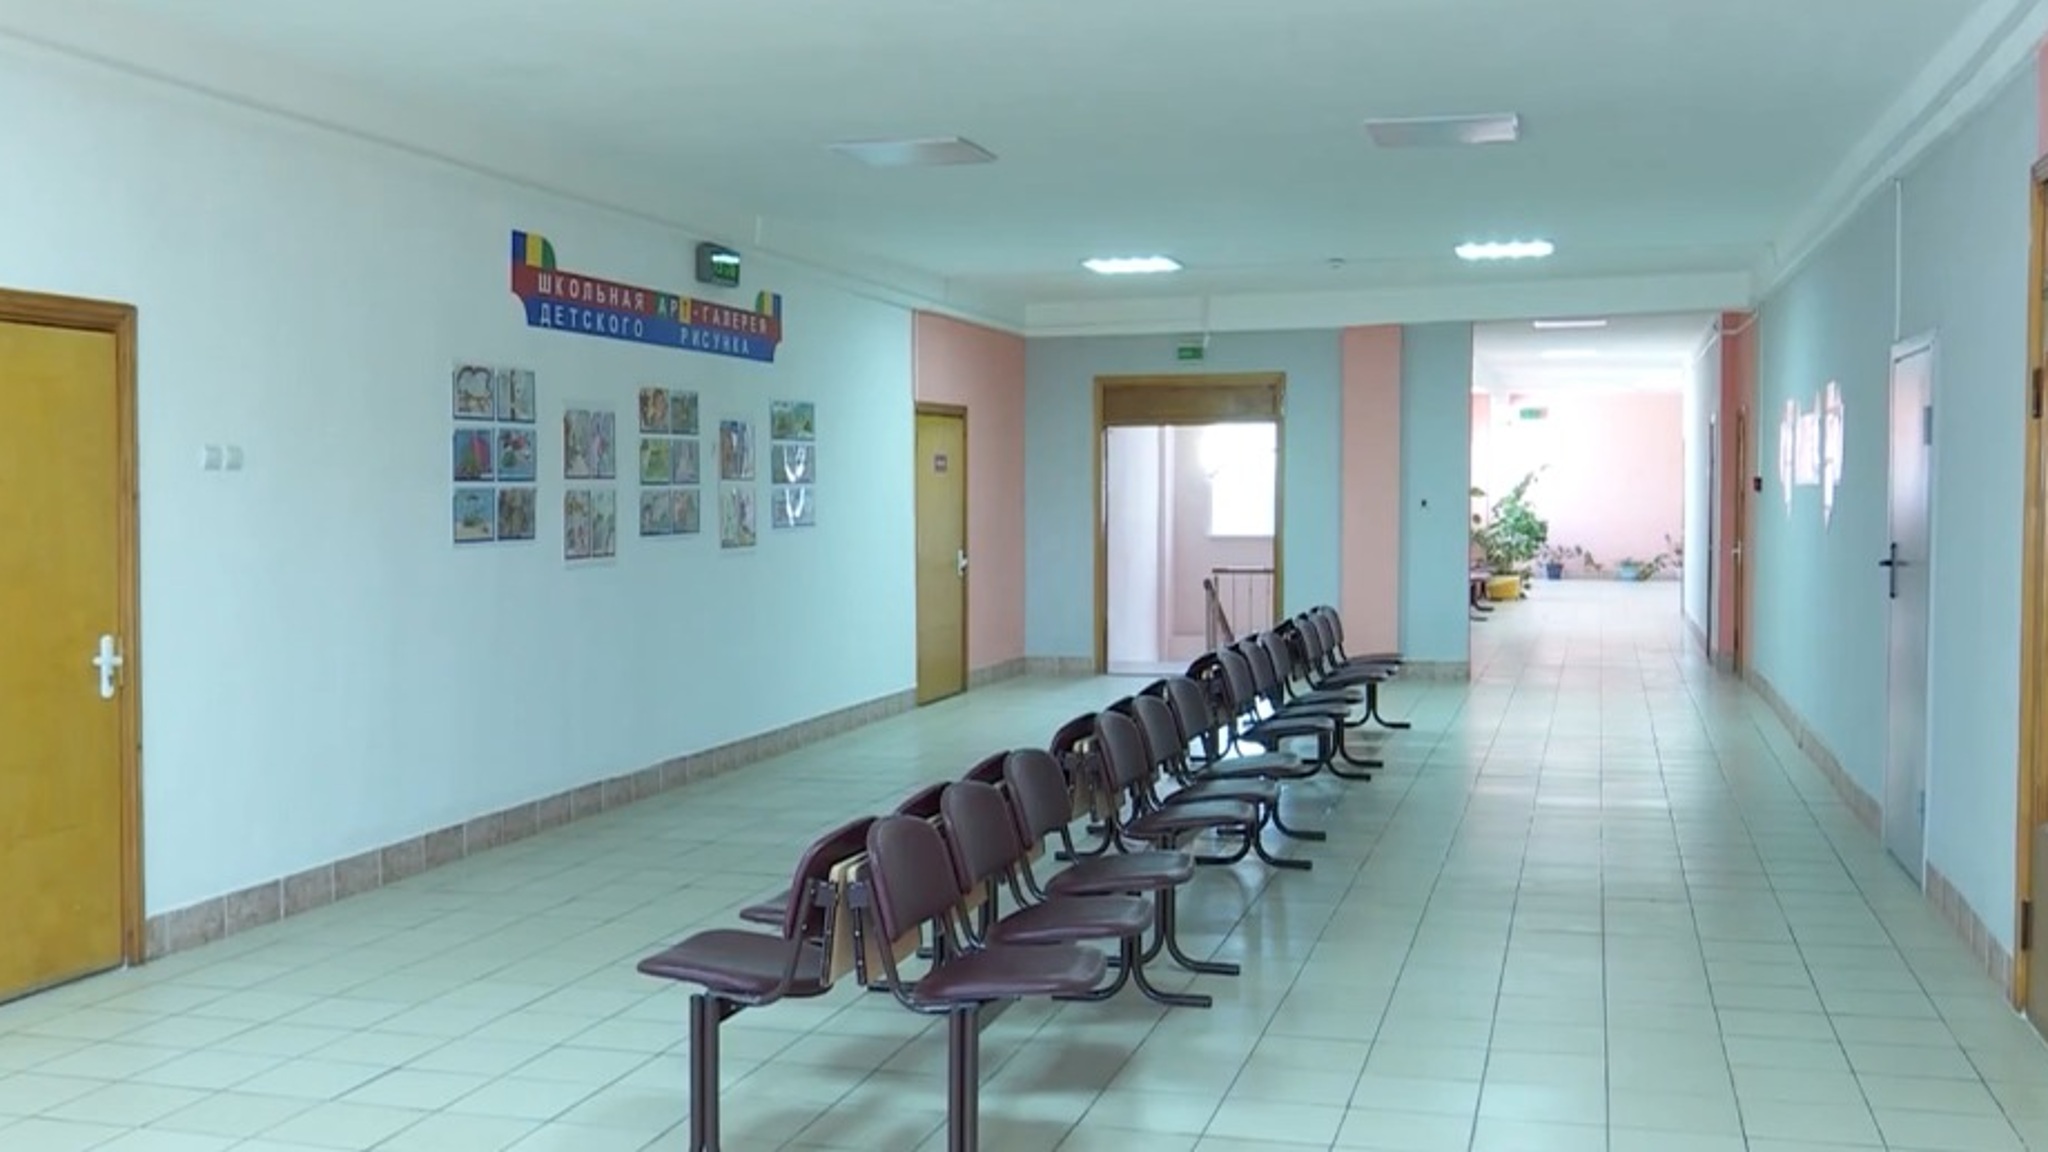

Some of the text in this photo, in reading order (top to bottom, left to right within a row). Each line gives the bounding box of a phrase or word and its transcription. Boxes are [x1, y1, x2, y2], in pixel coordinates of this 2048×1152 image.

[538, 272, 767, 333] ШКОЛЬНАЯ АРТ-ГАЛЕРЕЯ
[540, 303, 749, 354] ДЕТСКОГО РИСУНКА
